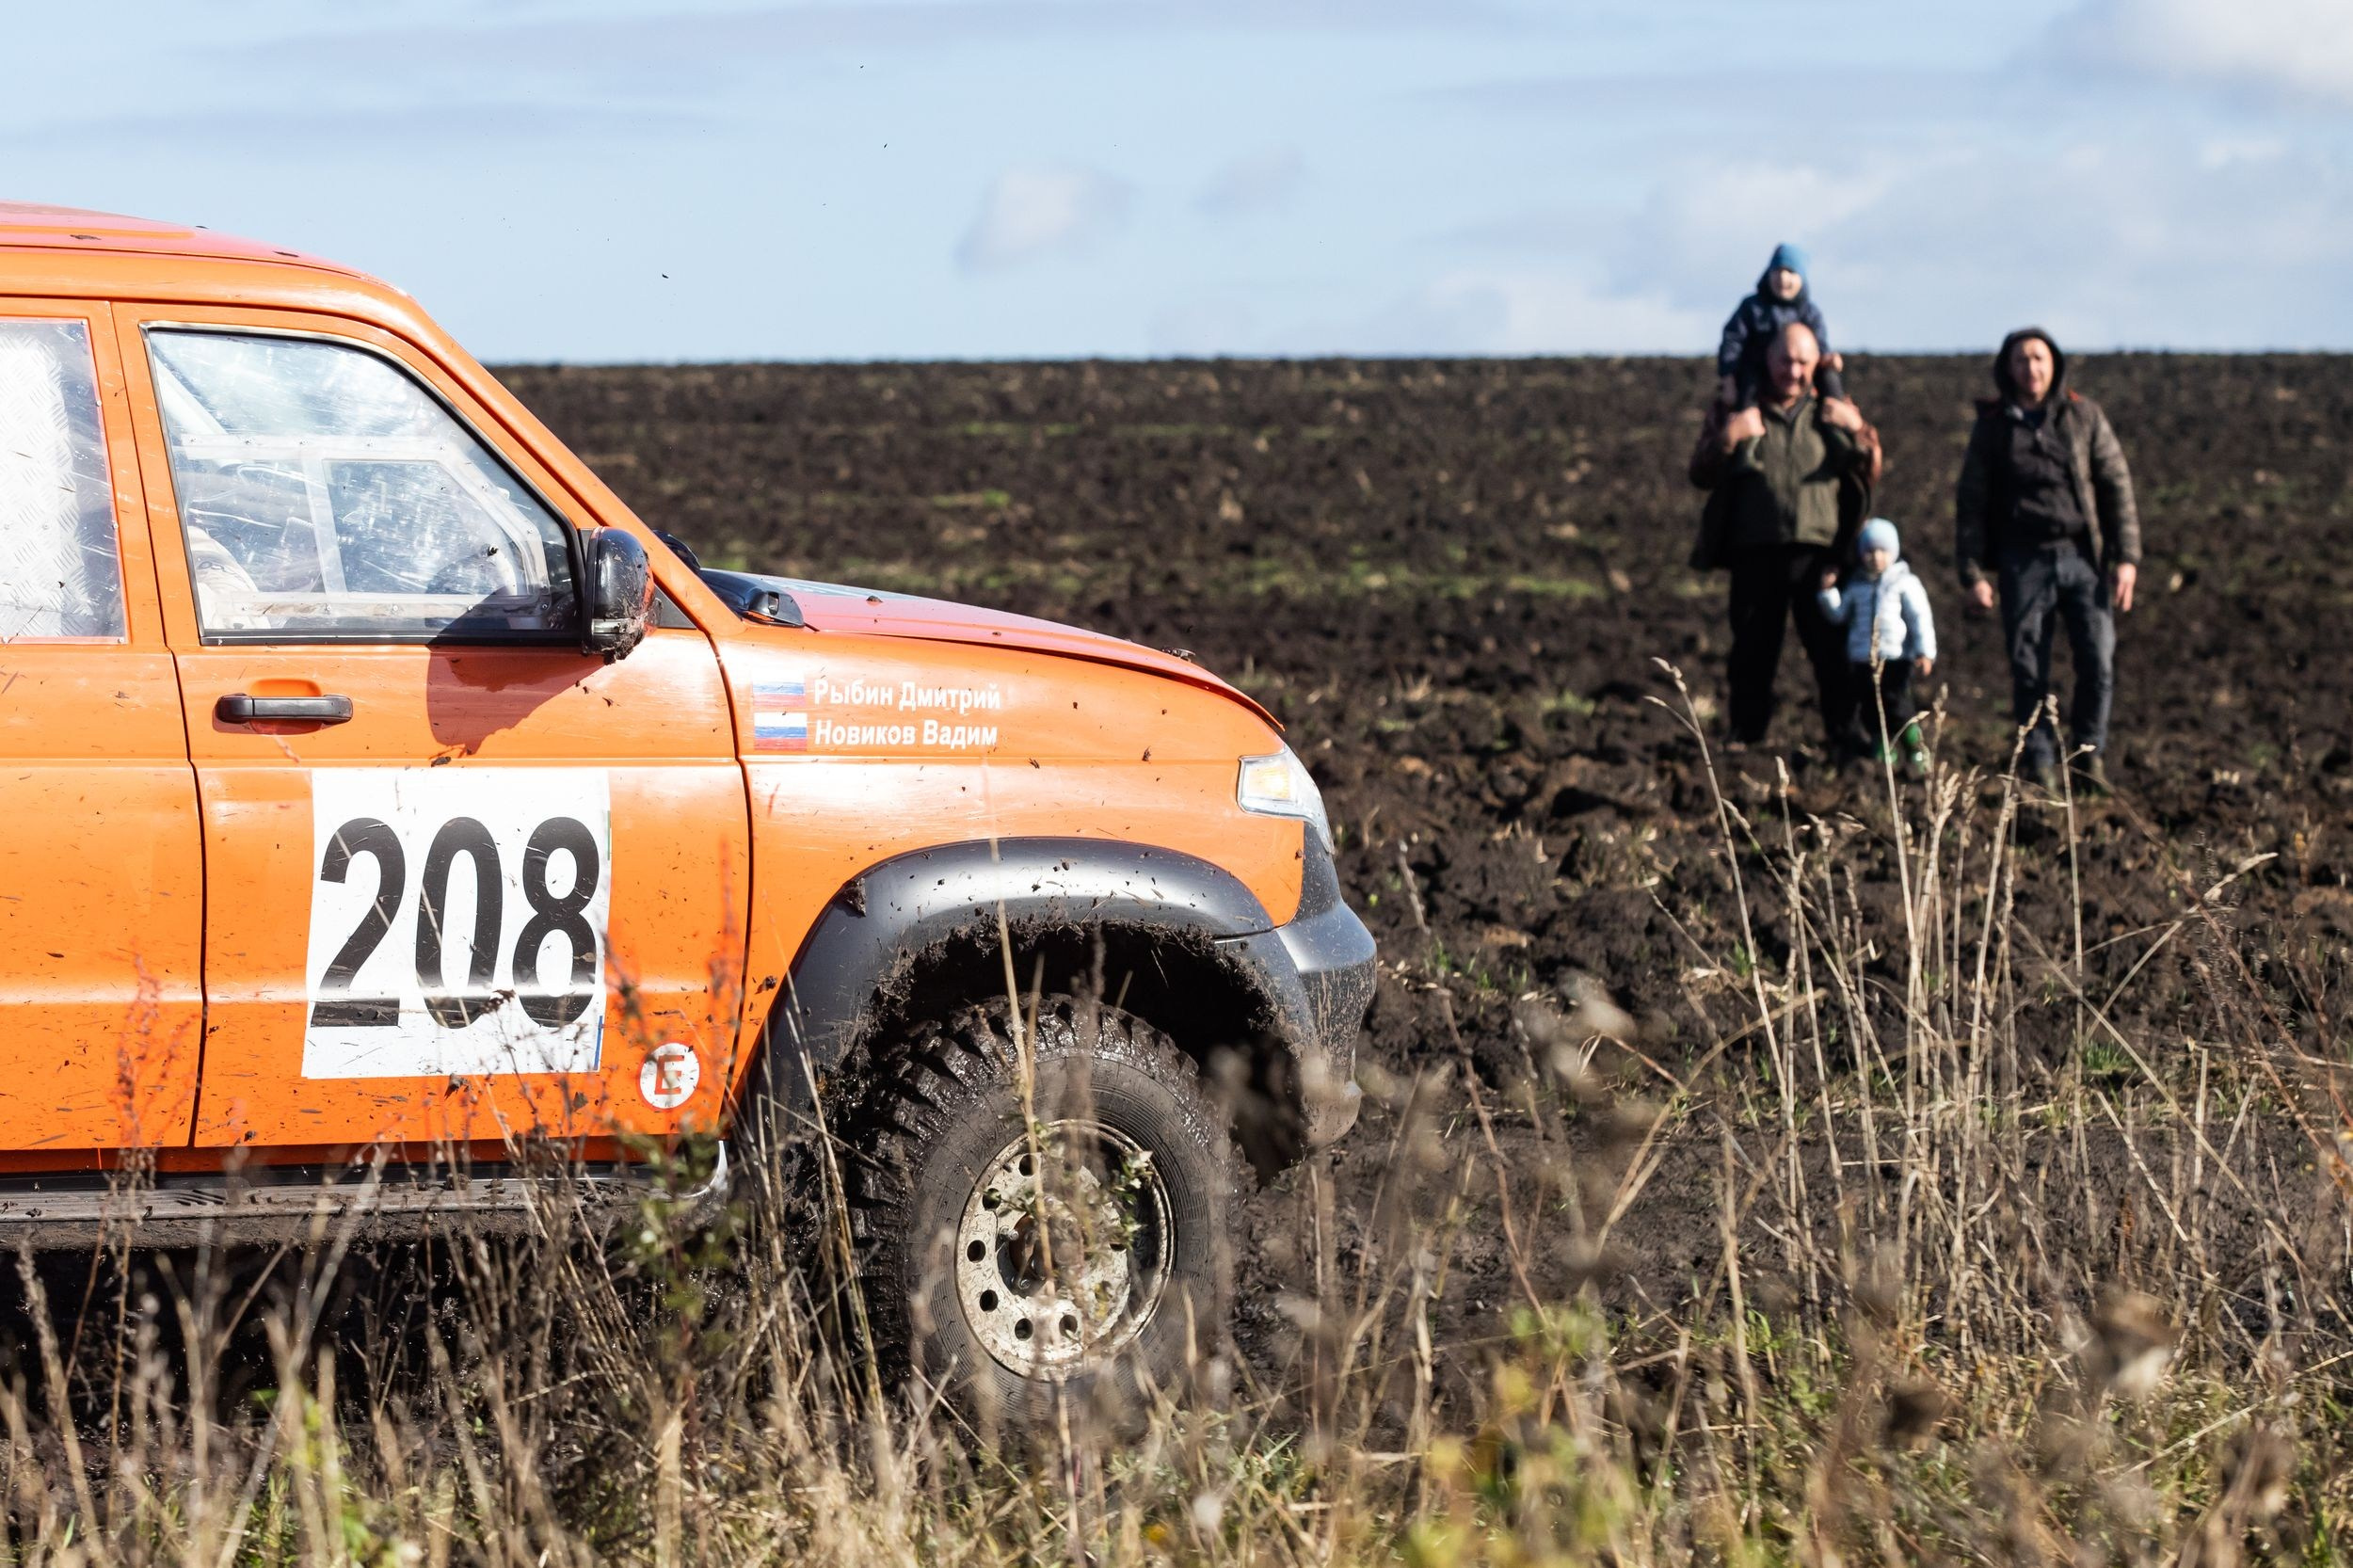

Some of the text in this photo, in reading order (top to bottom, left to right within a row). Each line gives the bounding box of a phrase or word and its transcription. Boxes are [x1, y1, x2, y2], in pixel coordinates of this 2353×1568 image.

[814, 679, 1000, 713] Рыбин Дмитрий
[814, 719, 998, 749] Новиков Вадим
[311, 816, 600, 1029] 208
